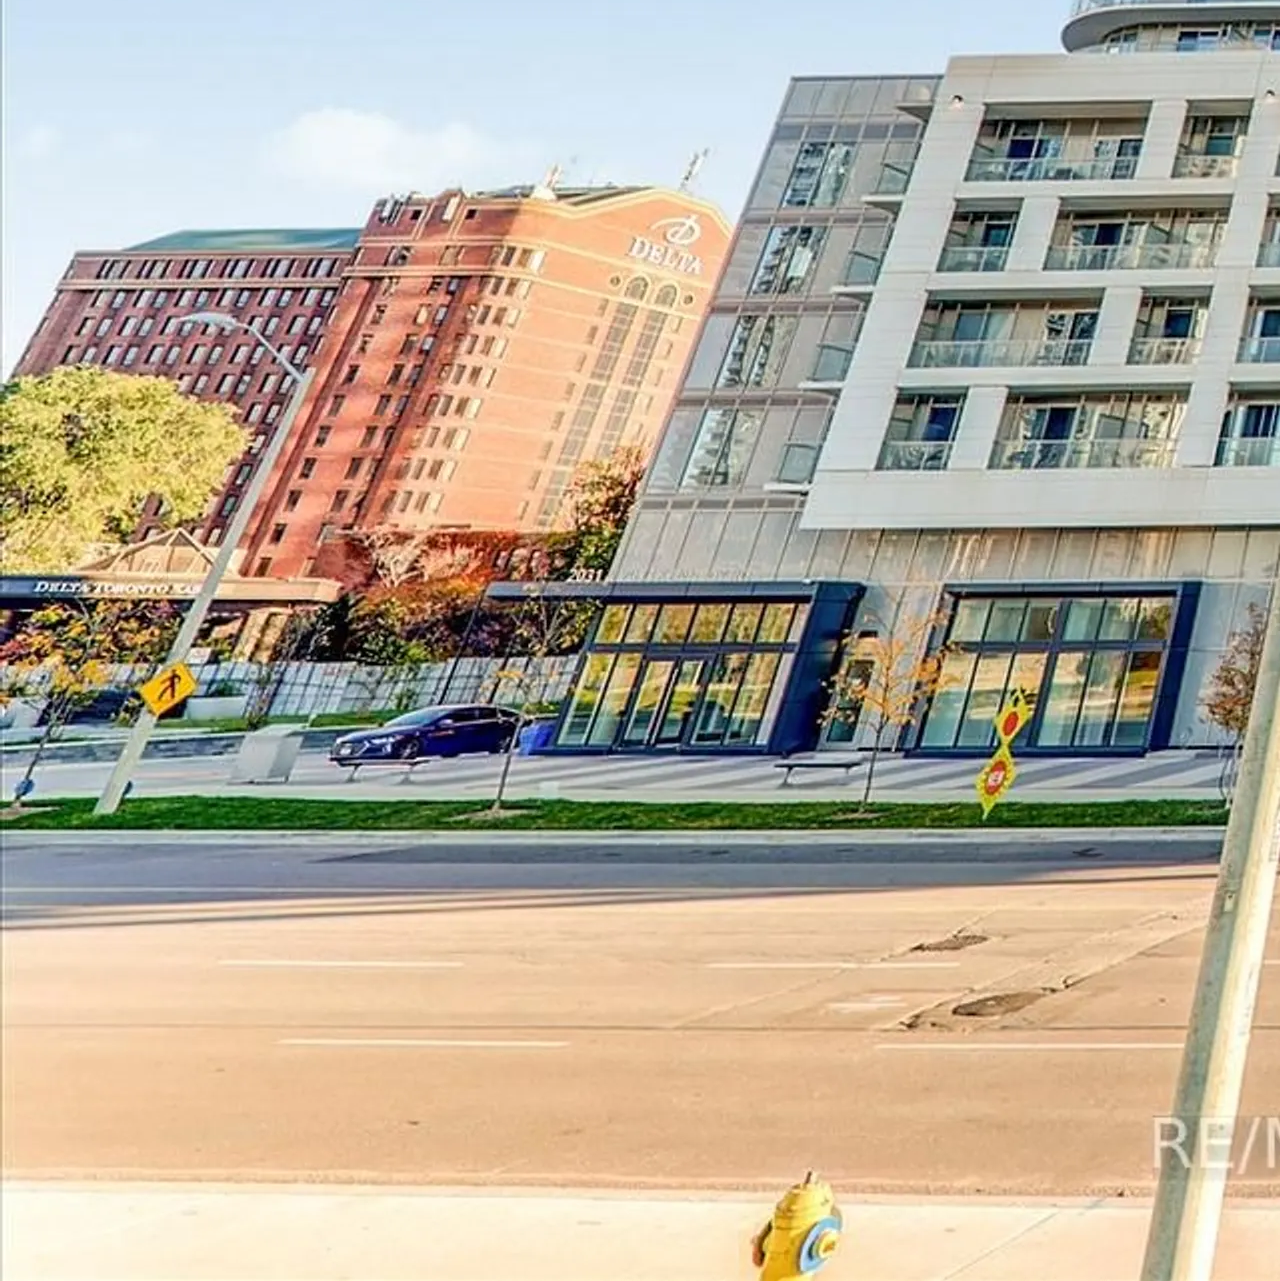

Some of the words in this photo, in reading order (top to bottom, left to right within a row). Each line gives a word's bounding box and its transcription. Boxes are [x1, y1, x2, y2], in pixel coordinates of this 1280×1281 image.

[627, 235, 703, 275] DELTA
[33, 581, 92, 594] DELTA
[94, 582, 170, 595] TORONTO
